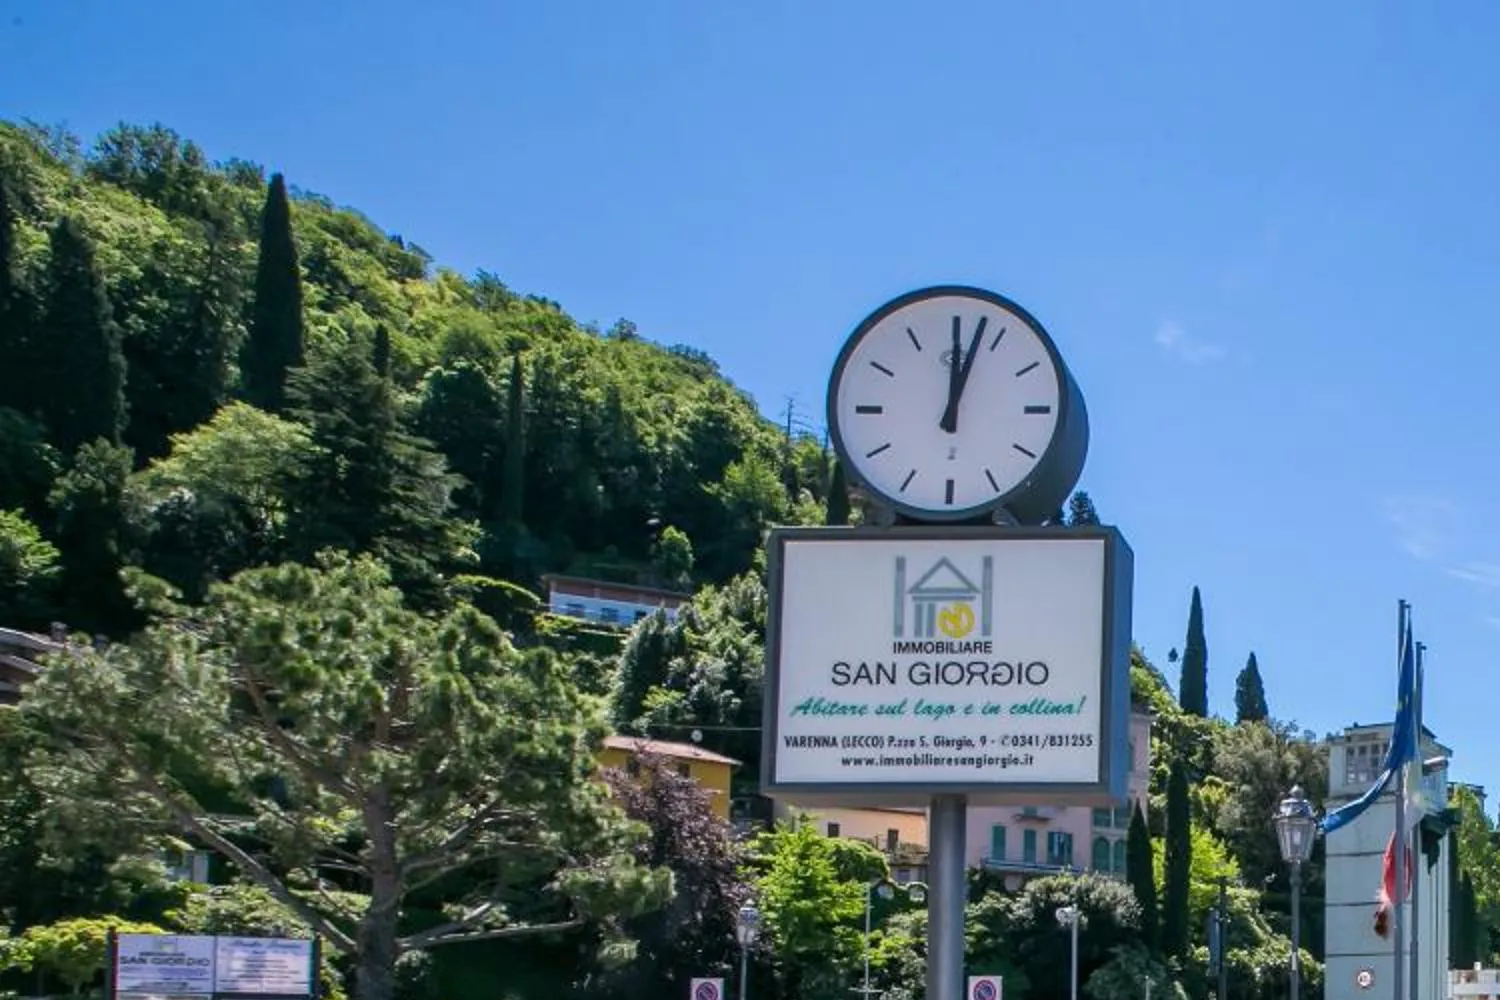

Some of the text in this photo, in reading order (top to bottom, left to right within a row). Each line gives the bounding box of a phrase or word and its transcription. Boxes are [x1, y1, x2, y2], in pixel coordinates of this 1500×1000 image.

[893, 641, 993, 655] IMMOBILIARE
[831, 661, 1049, 686] SAN GIORGIO
[789, 695, 1087, 721] Abitare sul lago e in collina!
[784, 735, 838, 748] VARENNA
[842, 735, 885, 750] (LECCO)
[919, 735, 930, 748] S.
[933, 735, 976, 751] Giorgio,
[979, 735, 987, 748] 9
[1011, 734, 1093, 749] 0341/831255
[841, 753, 1034, 769] www.immobiliaresangiorgio.it
